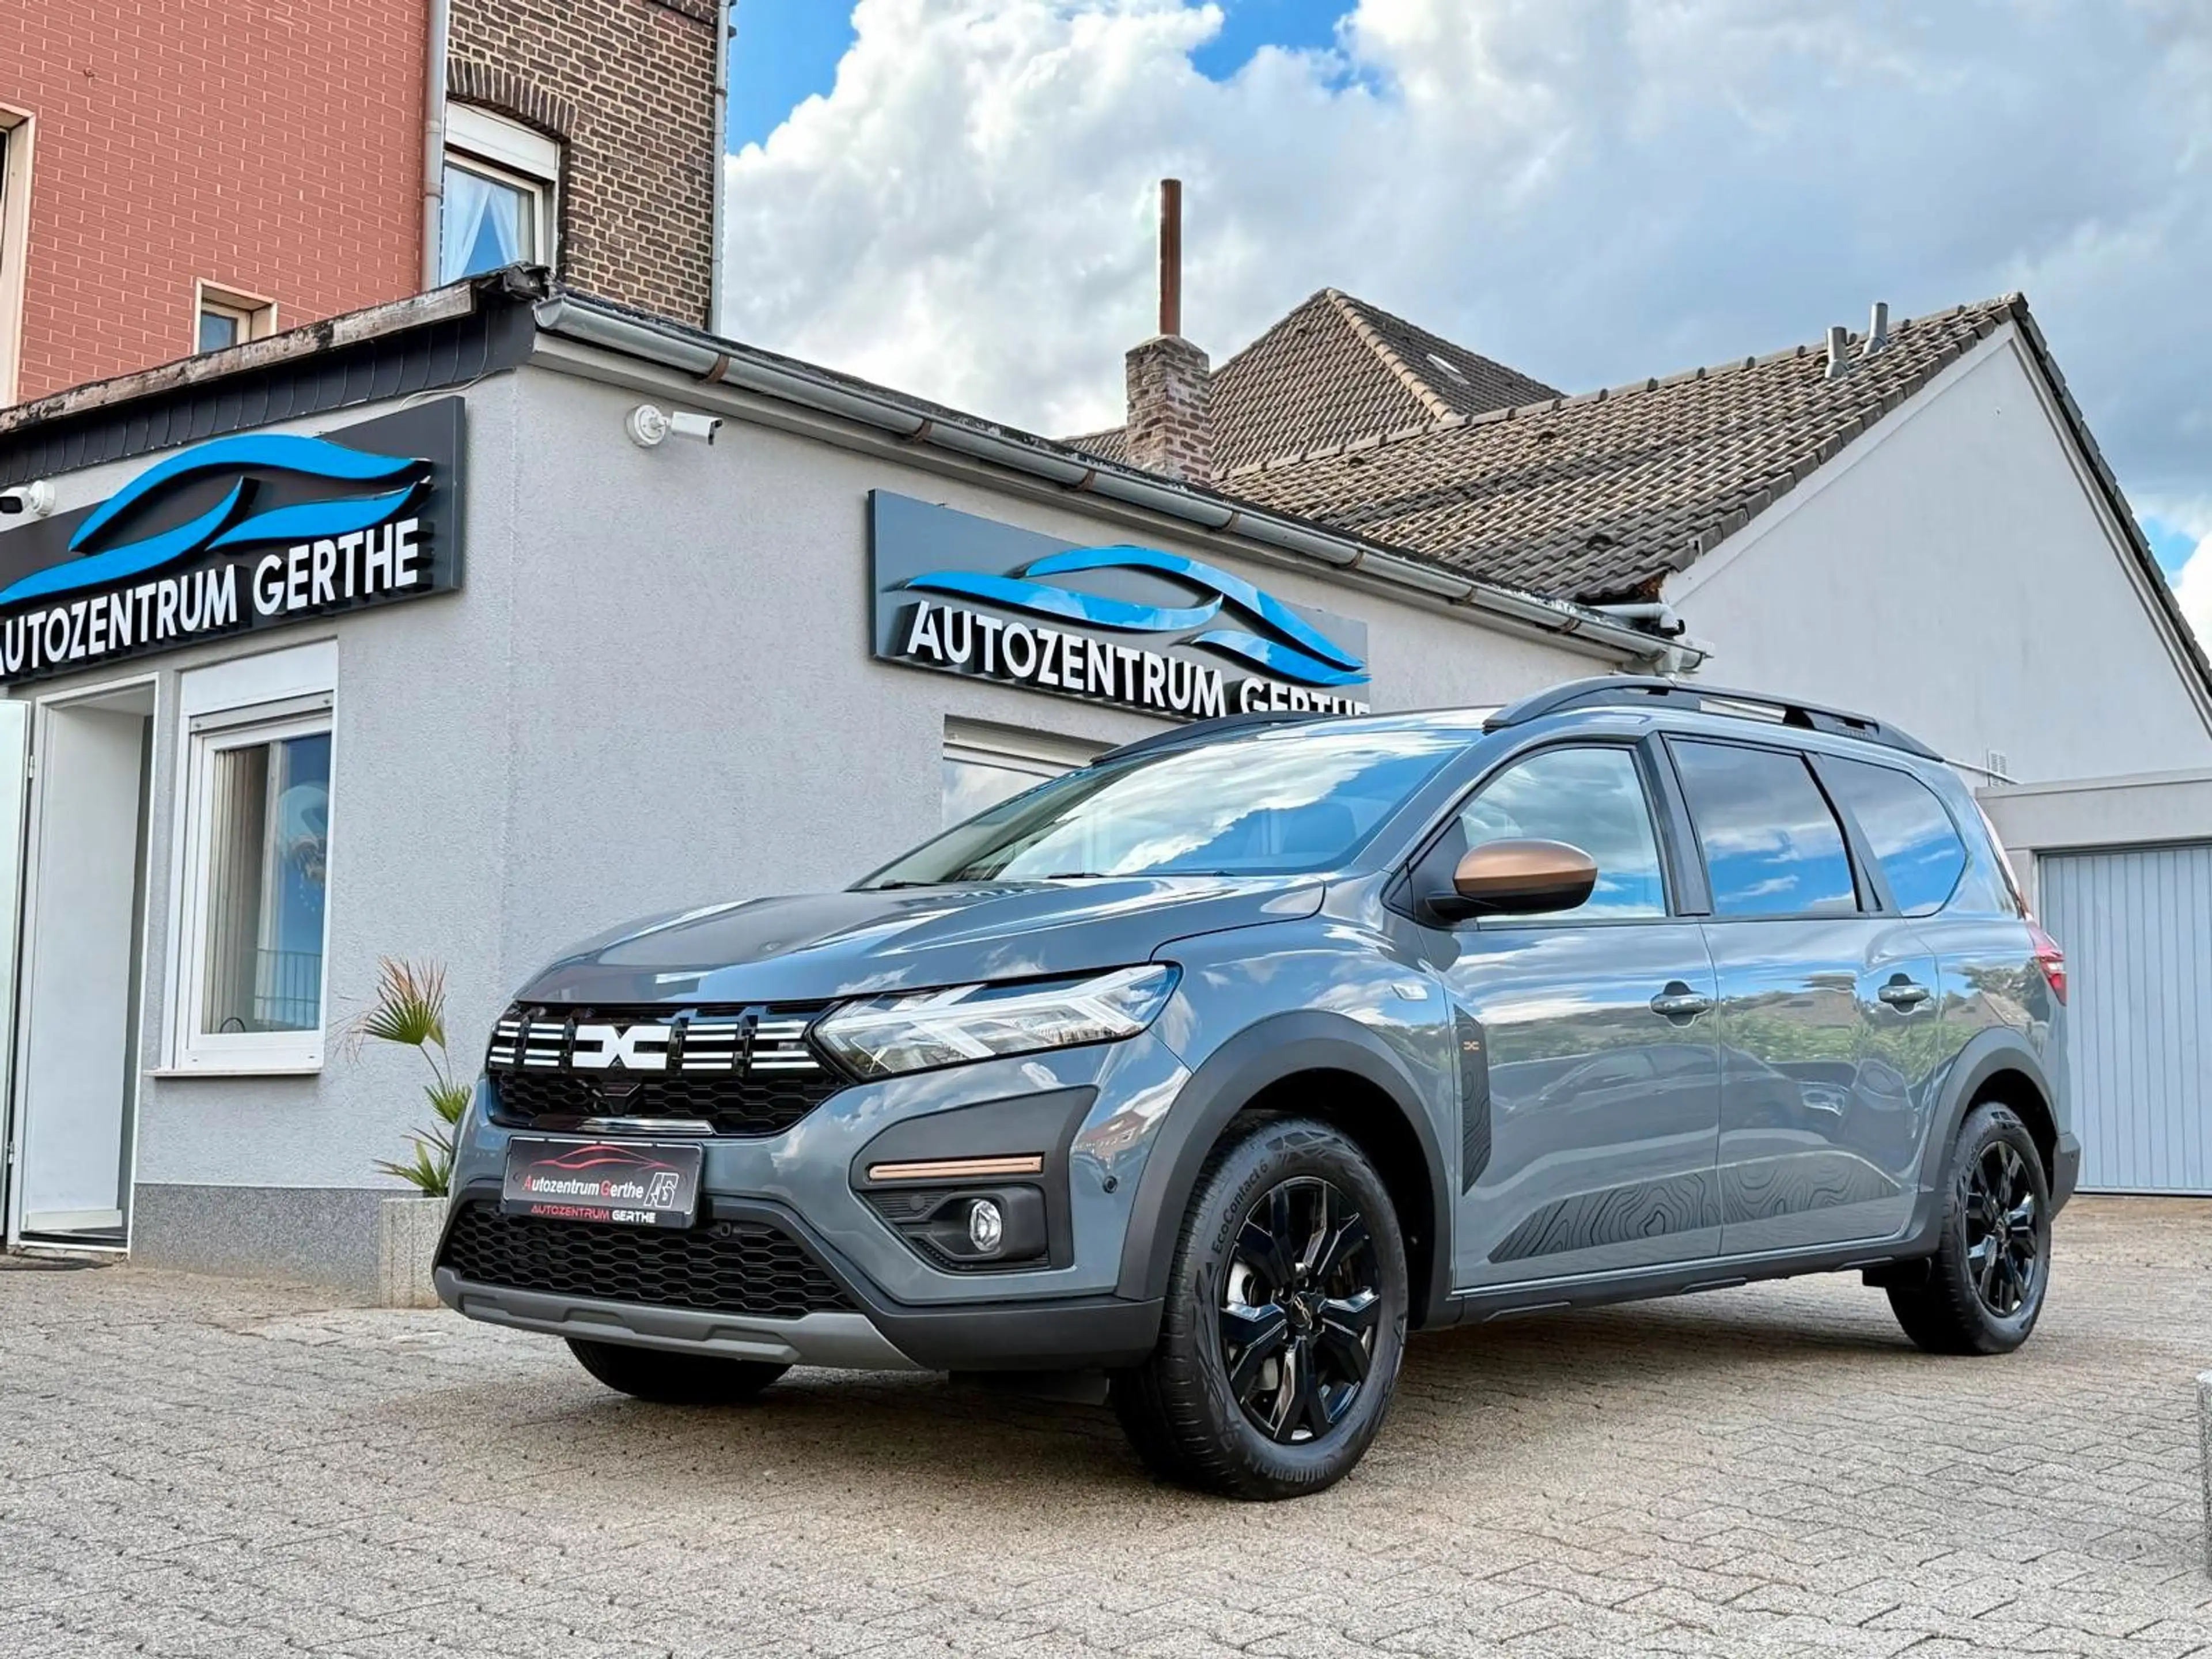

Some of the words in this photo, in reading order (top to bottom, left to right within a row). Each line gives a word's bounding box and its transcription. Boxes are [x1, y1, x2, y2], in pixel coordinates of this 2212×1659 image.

[253, 518, 419, 616] GERTHE
[907, 601, 1226, 718] AUTOZENTRUM
[531, 1204, 609, 1221] AUTOZENTRUM
[612, 1210, 656, 1223] GERTHE
